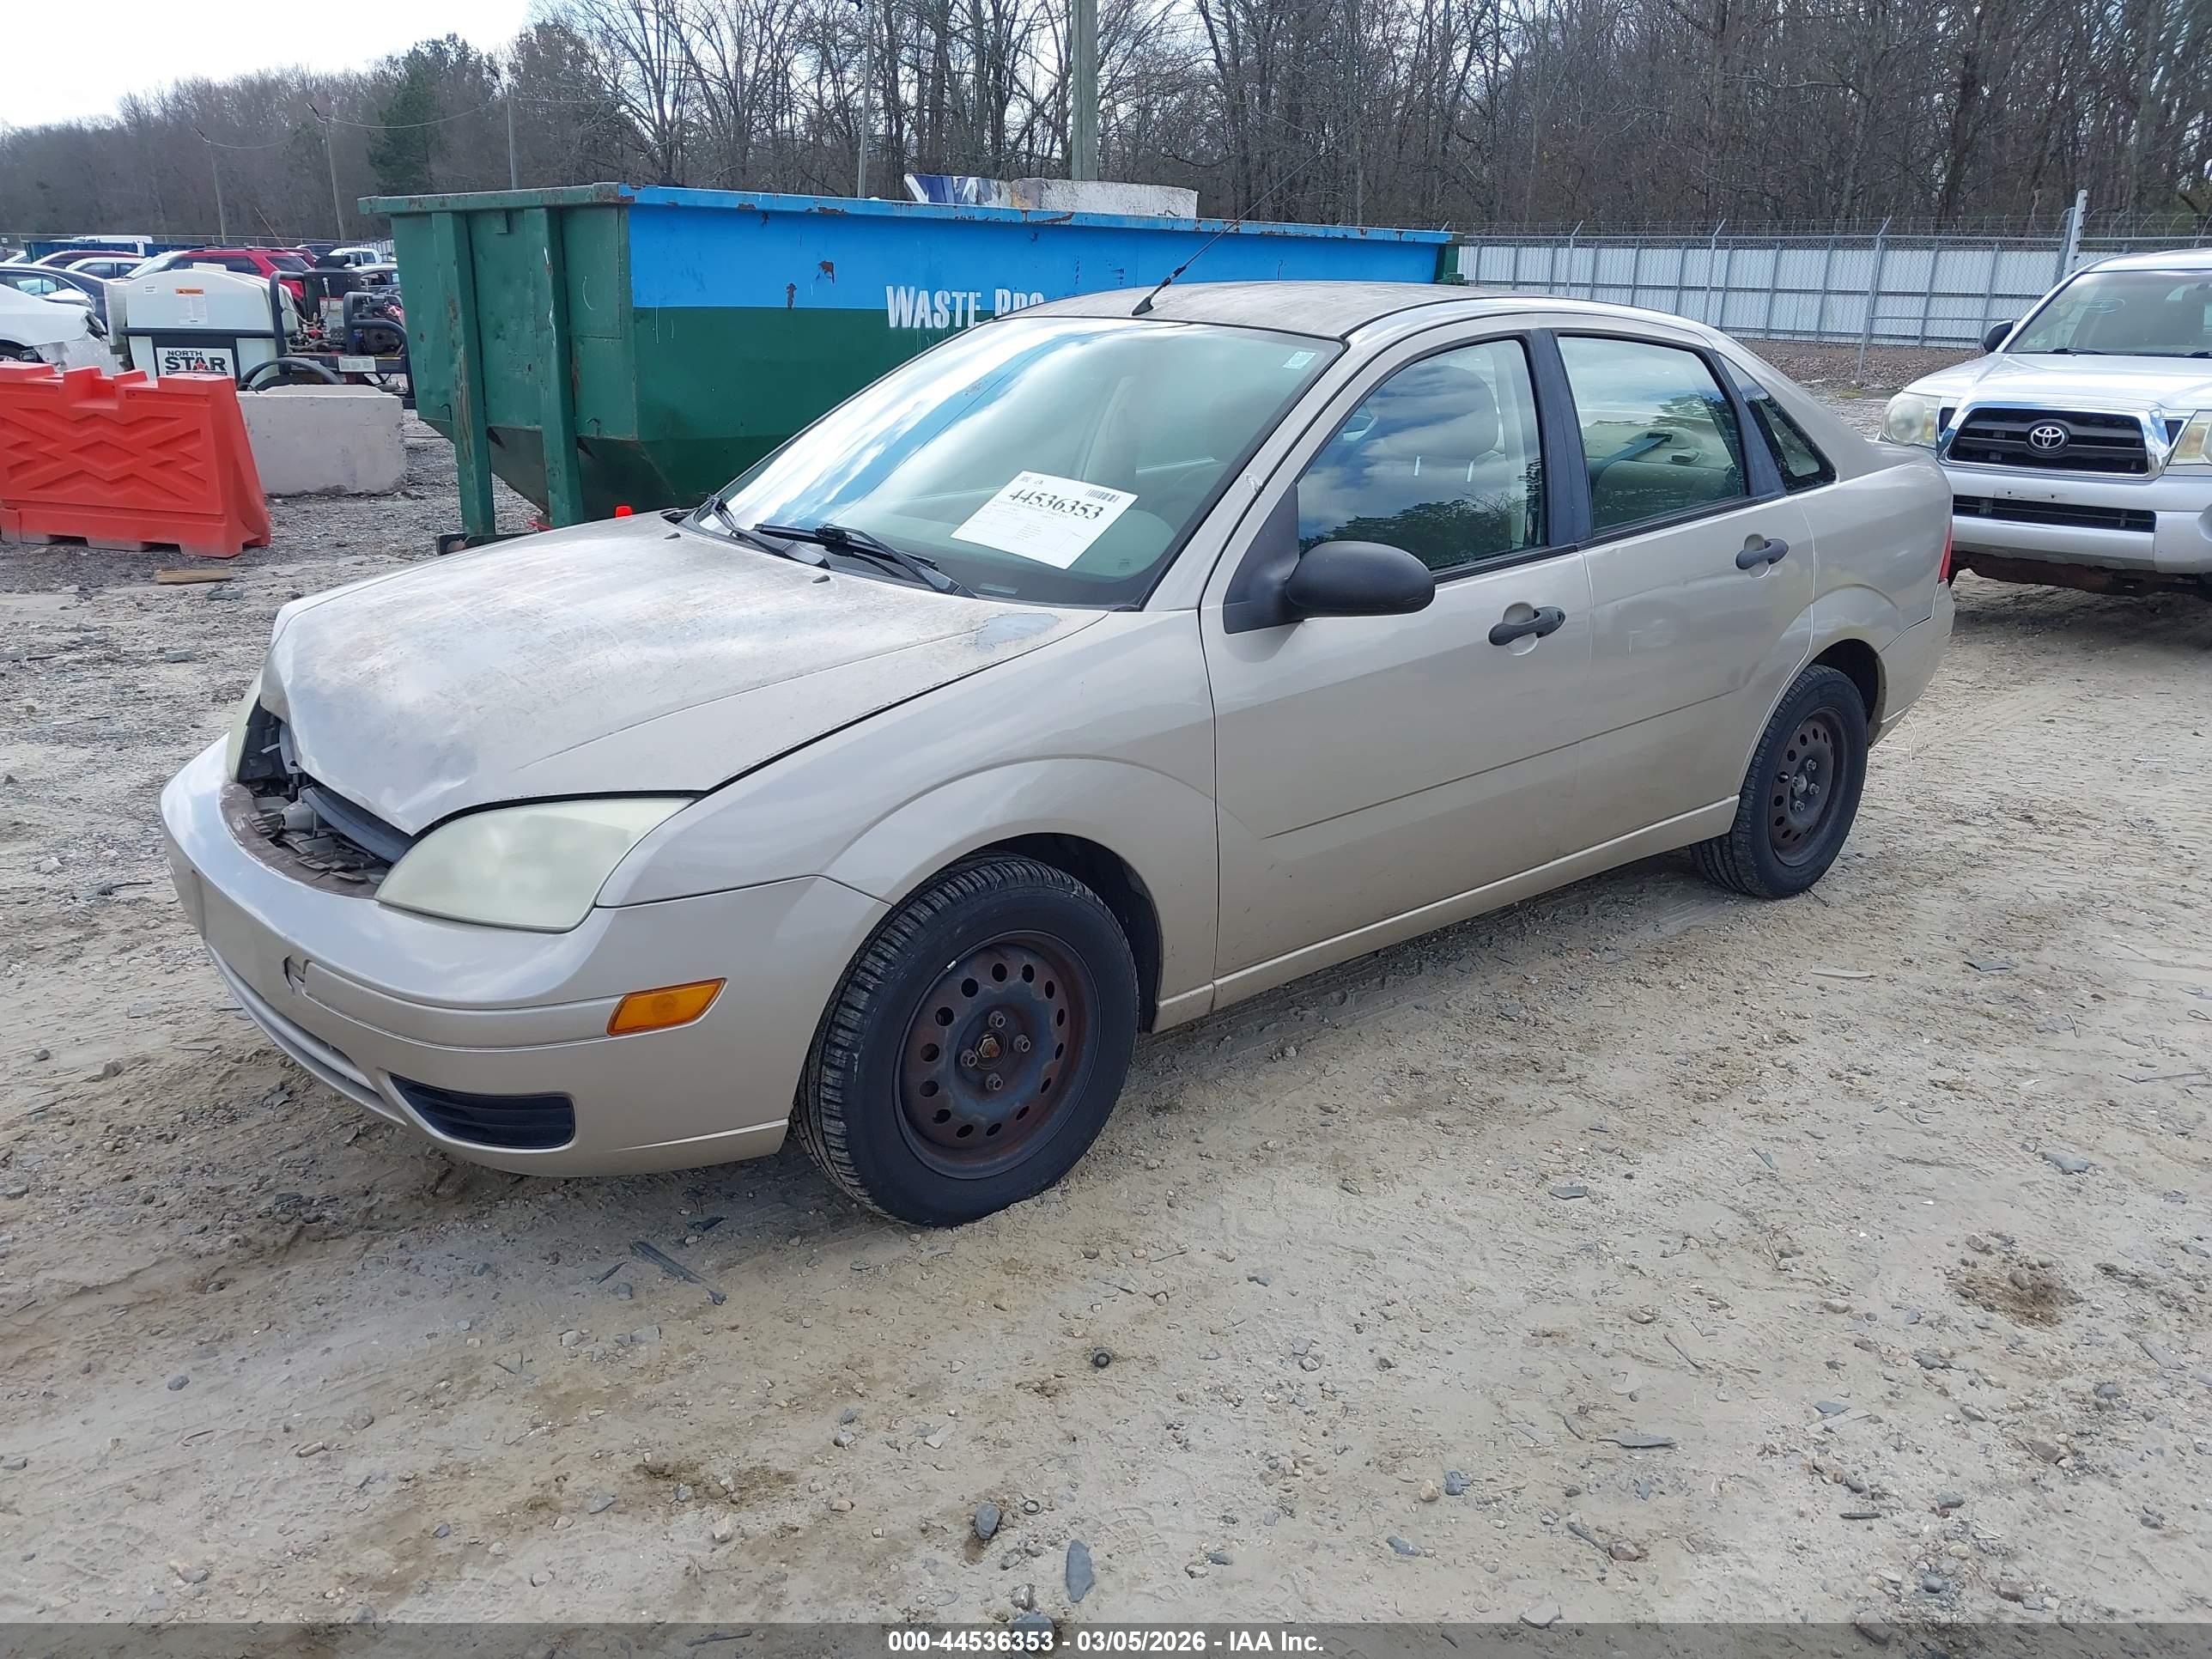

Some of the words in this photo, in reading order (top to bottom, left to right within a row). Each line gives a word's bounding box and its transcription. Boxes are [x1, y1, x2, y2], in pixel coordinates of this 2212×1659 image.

[885, 285, 982, 329] WASTE
[164, 356, 227, 371] STAR
[1008, 488, 1105, 520] 44536353
